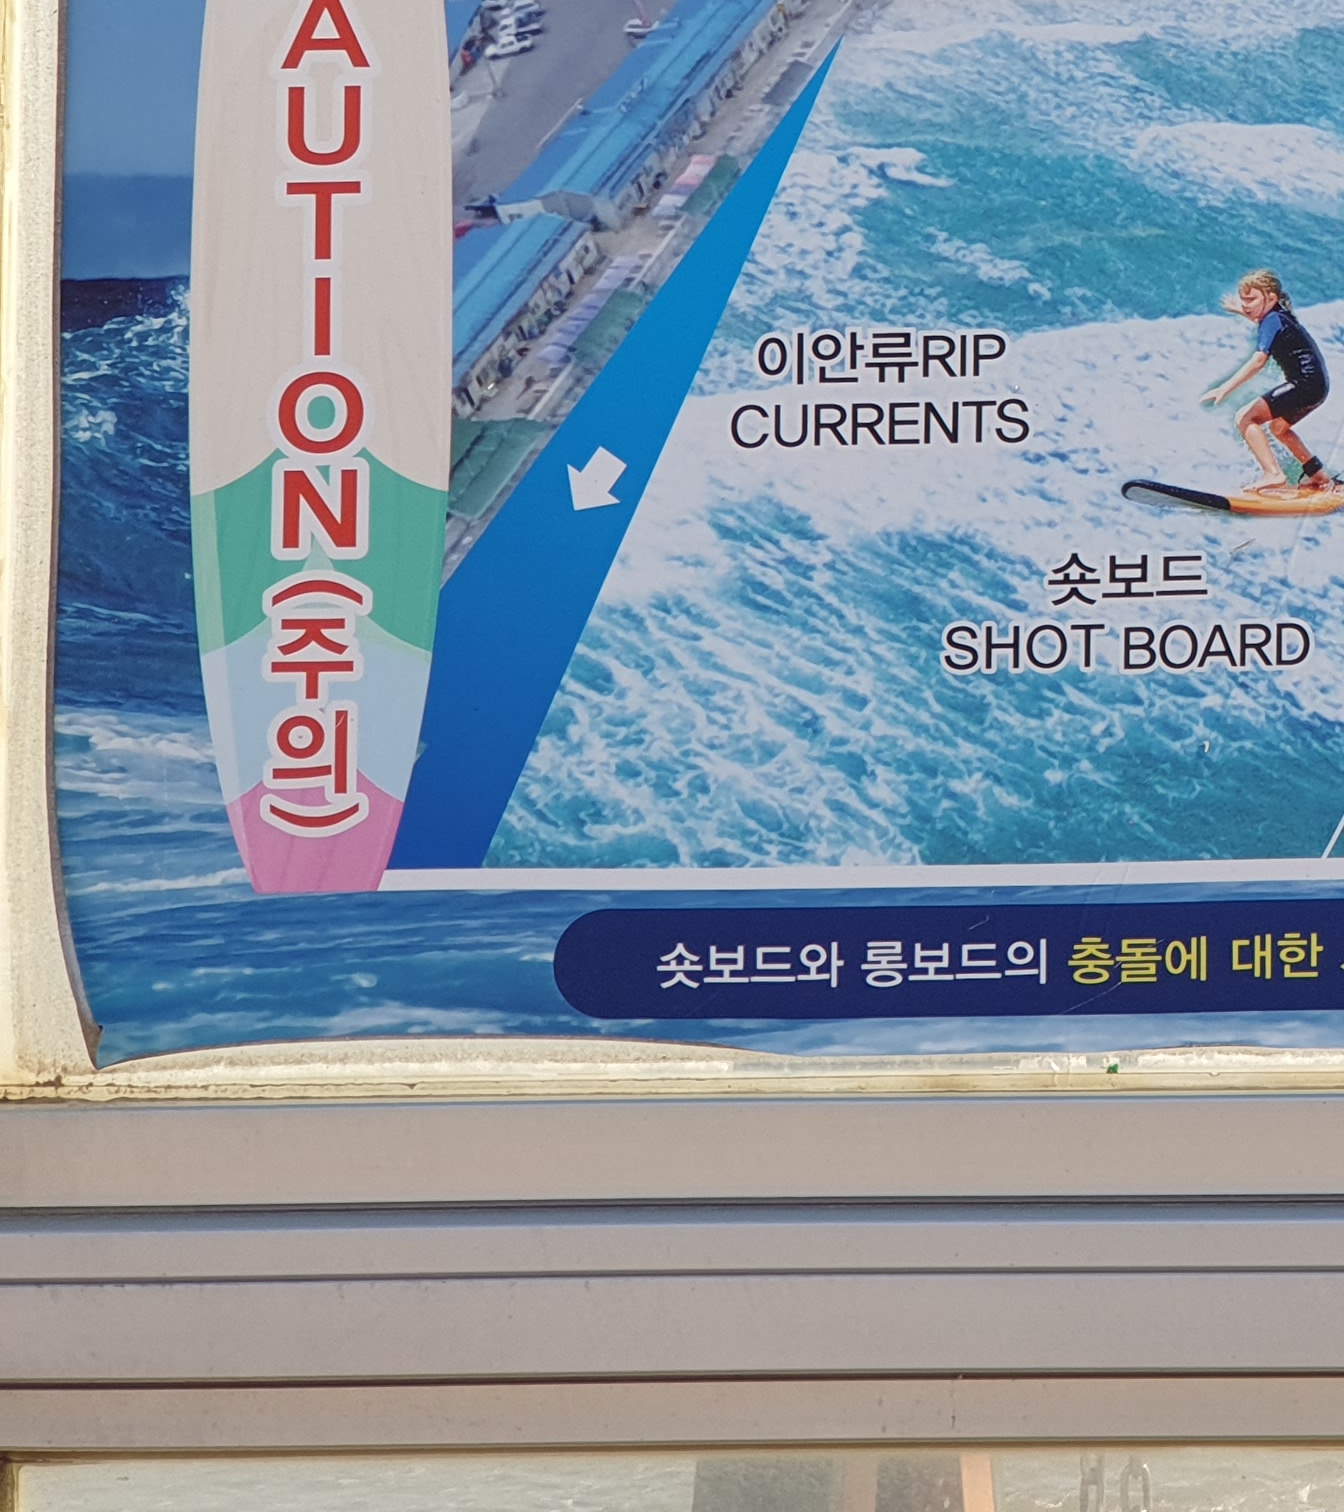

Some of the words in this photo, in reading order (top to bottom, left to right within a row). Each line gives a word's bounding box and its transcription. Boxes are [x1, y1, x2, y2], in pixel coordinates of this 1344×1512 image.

[730, 398, 1030, 448] CURRENTS
[1048, 552, 1208, 606] 숏보드
[943, 624, 1104, 671] SHOT
[1122, 622, 1312, 670] BOARD
[656, 941, 844, 991] 숏보드와
[861, 938, 1050, 988] 롱보드의
[1067, 935, 1211, 985] 충돌에
[1230, 932, 1324, 982] 대한
